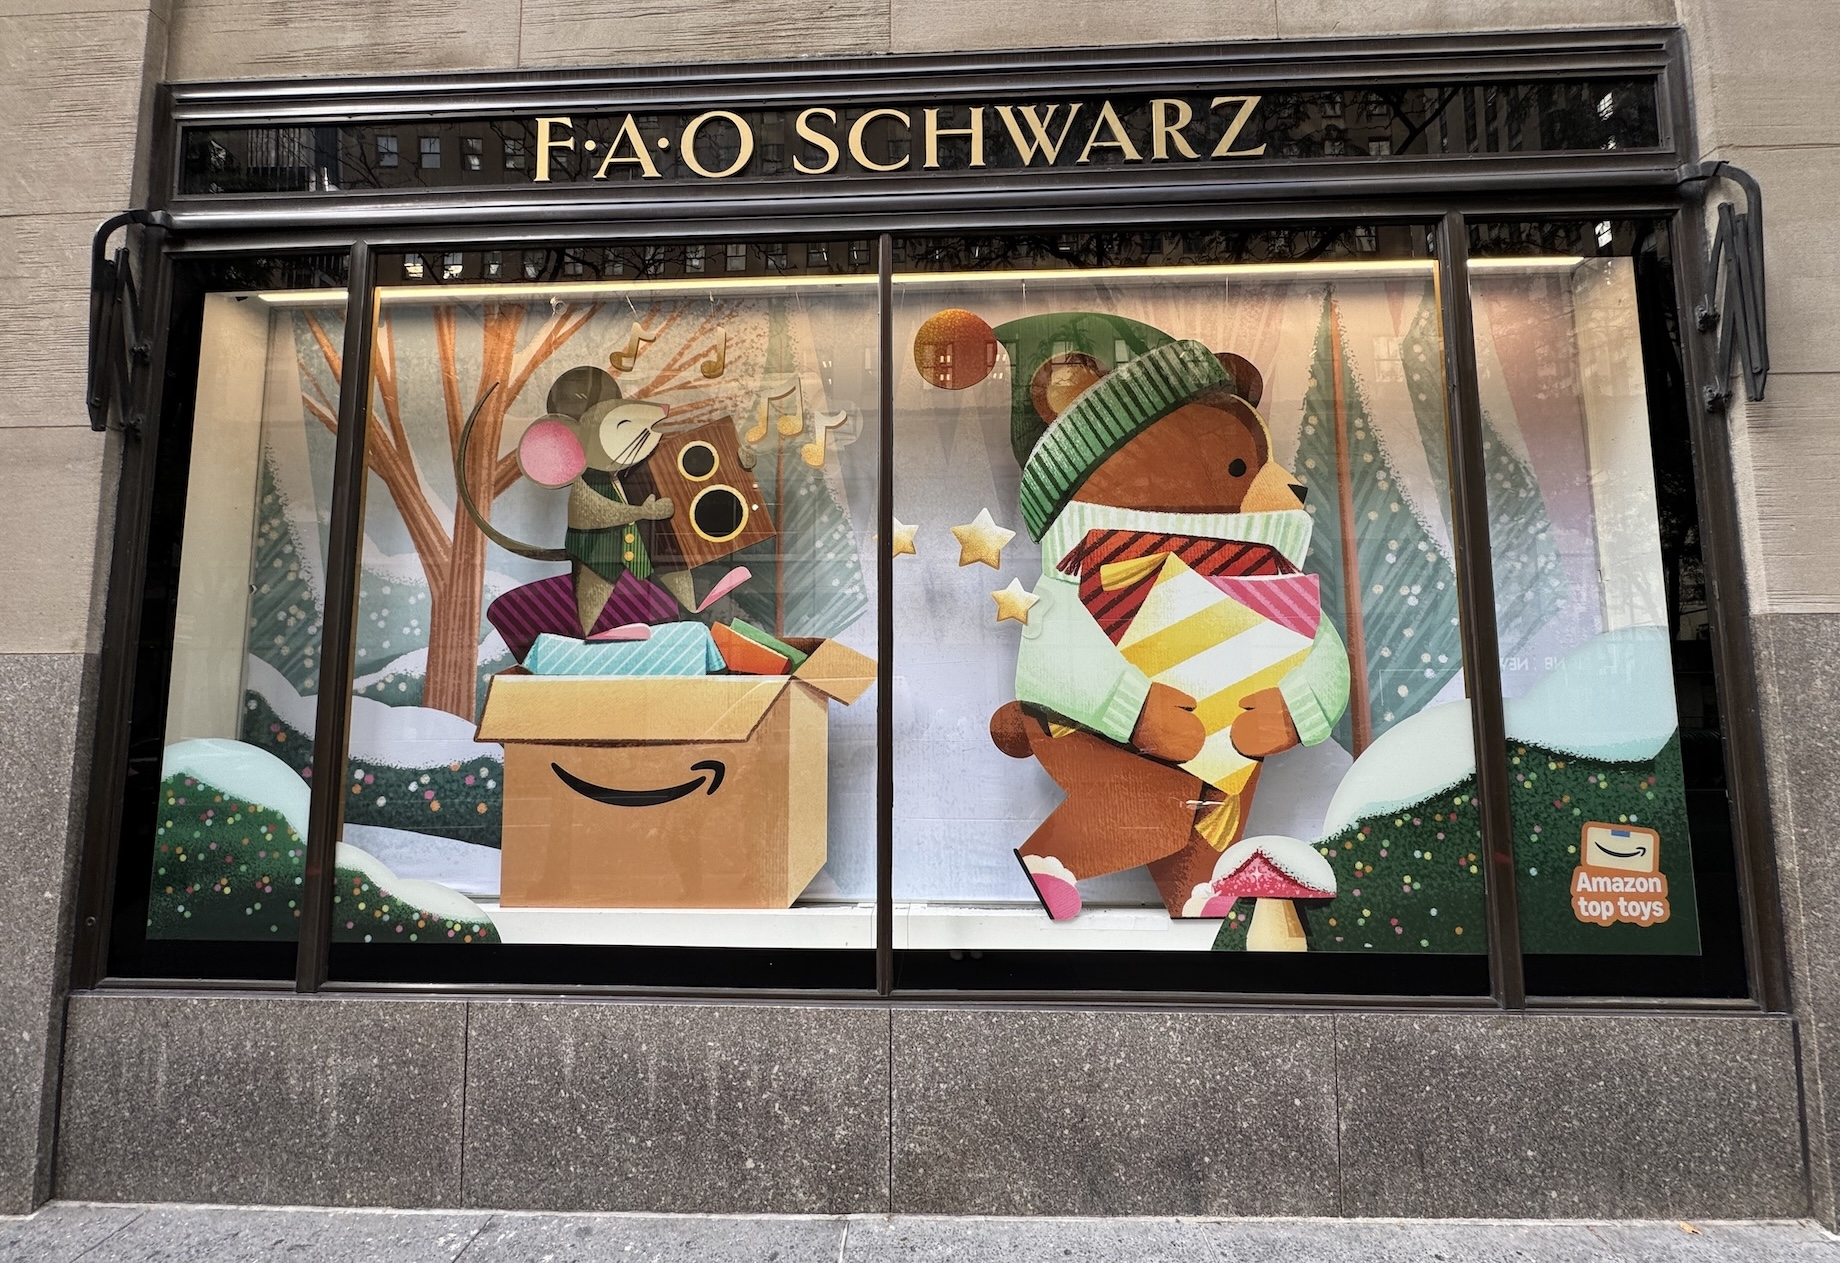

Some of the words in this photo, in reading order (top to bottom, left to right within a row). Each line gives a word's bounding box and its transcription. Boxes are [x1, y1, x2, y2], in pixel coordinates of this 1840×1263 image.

[793, 96, 1267, 174] SCHWARZ
[1576, 872, 1662, 893] Amazon
[1578, 897, 1614, 920] top
[1617, 897, 1664, 920] toys
